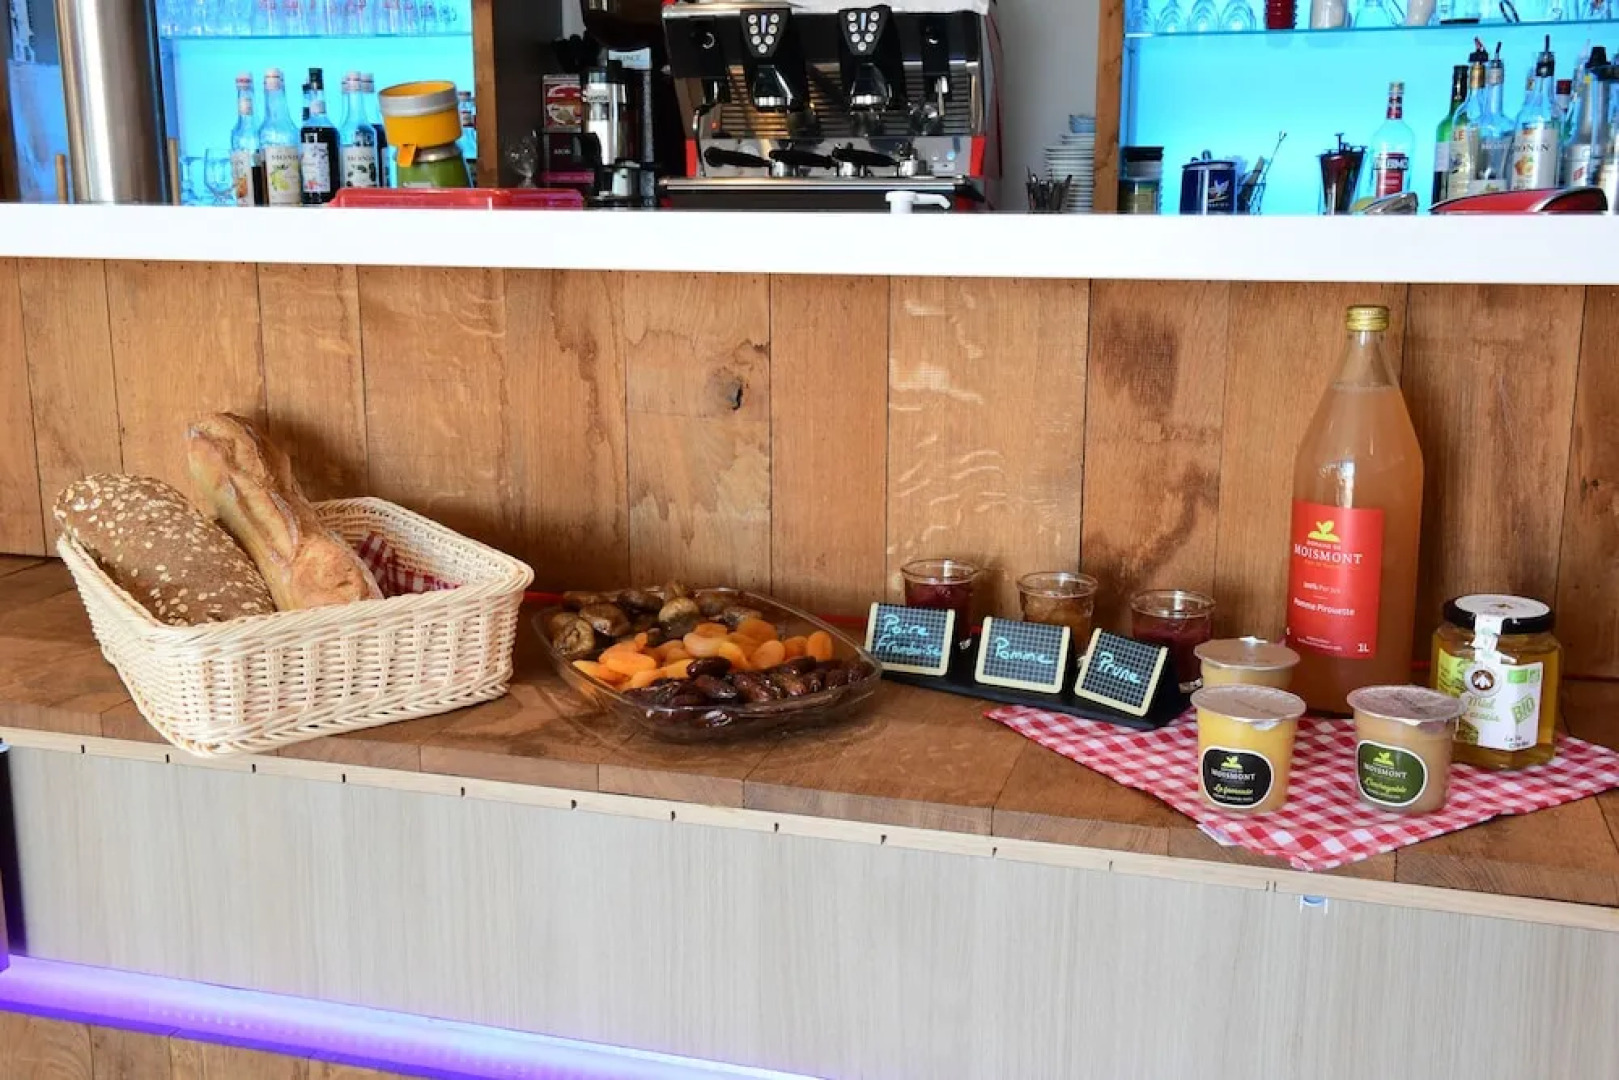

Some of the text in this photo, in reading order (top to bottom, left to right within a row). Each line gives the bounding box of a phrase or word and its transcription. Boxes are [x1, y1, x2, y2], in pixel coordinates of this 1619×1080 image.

[1294, 543, 1363, 564] MOISMONT
[883, 613, 929, 635] Poire
[994, 637, 1055, 665] Pomme
[1358, 643, 1370, 653] 1L
[1099, 651, 1141, 684] Prune
